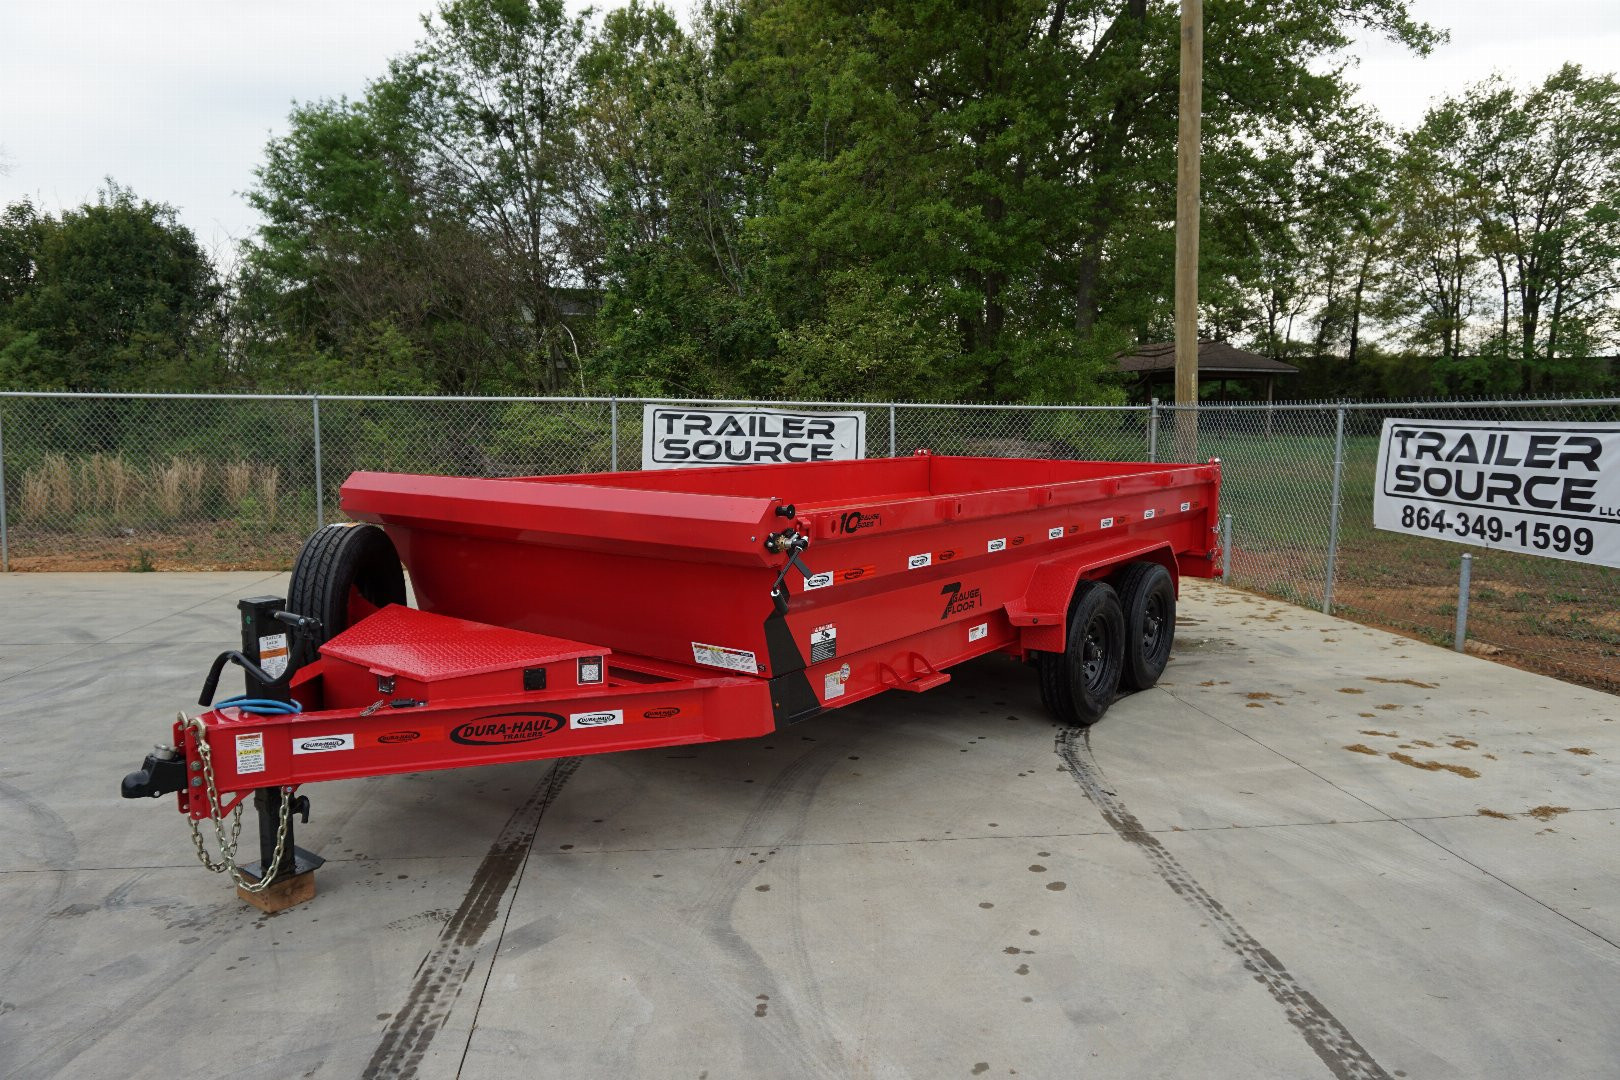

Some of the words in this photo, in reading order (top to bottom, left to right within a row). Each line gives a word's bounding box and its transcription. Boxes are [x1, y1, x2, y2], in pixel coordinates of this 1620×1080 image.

[658, 413, 835, 440] TRAILER
[663, 439, 834, 463] SOURCE
[1394, 429, 1603, 472] TRAILER
[1393, 464, 1598, 513] SOURCE
[840, 511, 861, 535] 10
[1401, 505, 1594, 556] 864-349-1599
[940, 581, 962, 620] 7
[952, 588, 980, 603] GAUGE
[463, 719, 553, 738] DURA-HAUL
[502, 731, 543, 741] TRAILERS
